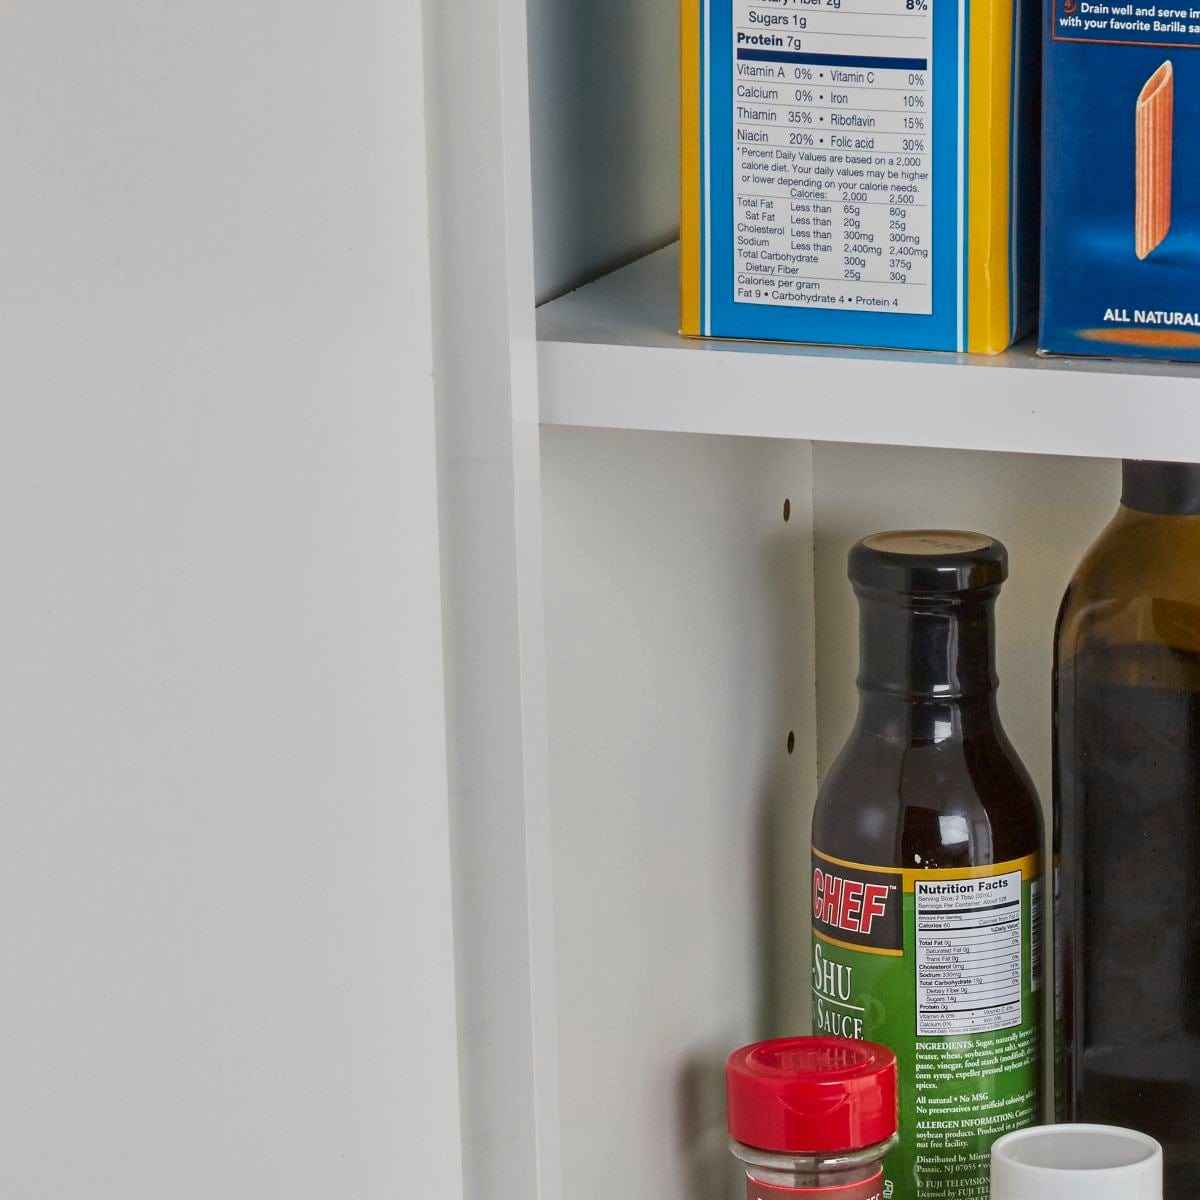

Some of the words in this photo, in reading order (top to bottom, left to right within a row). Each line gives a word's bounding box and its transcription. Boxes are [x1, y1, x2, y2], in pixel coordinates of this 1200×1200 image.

[906, 0, 927, 11] 8%
[1081, 3, 1109, 14] Drain
[1111, 5, 1132, 16] well
[1135, 7, 1154, 17] and
[1157, 10, 1187, 18] serve
[748, 13, 789, 26] Sugars
[792, 15, 806, 28] 1g
[1060, 18, 1081, 27] with
[1084, 22, 1107, 30] your
[1110, 19, 1150, 31] favorite
[1153, 21, 1186, 33] Barilla
[737, 33, 783, 47] Protein
[787, 37, 801, 50] 7g
[737, 65, 774, 77] Vitamin
[776, 67, 785, 78] A
[794, 68, 812, 80] 0%
[831, 71, 864, 83] Vitamin
[866, 72, 874, 83] C
[908, 74, 924, 85] 0%
[737, 87, 778, 100] Calcium
[795, 90, 812, 101] 0%
[831, 93, 848, 103] Iron
[903, 96, 924, 107] 10%
[737, 107, 776, 121] Thiamin
[789, 112, 812, 124] 35%
[831, 115, 875, 127] Riboflavin
[903, 118, 923, 129] 15%
[737, 130, 768, 142] Niacin
[790, 133, 813, 146] 20%
[831, 136, 852, 148] Folic
[855, 138, 874, 149] acid
[903, 140, 923, 151] 30%
[776, 150, 796, 161] Daily
[799, 152, 827, 162] Values
[845, 155, 871, 165] based
[896, 158, 921, 168] 2,000
[742, 161, 769, 173] calorie
[771, 163, 789, 173] diet.
[792, 164, 812, 174] Your
[815, 166, 834, 177] daily
[837, 168, 864, 177] values
[866, 171, 885, 181] may
[888, 170, 899, 179] be
[901, 171, 928, 183] higher
[752, 175, 775, 185] lower
[777, 177, 821, 190] depending
[838, 182, 857, 191] your
[859, 181, 888, 192] calorie
[890, 182, 919, 193] needs.
[737, 198, 757, 208] Total
[760, 199, 773, 209] Fat
[790, 202, 810, 212] Less
[813, 204, 831, 214] than
[844, 205, 860, 216] 65g
[889, 207, 905, 218] 80g
[738, 249, 758, 259] Total
[761, 250, 818, 264] Carbohydrate
[844, 257, 865, 268] 300g
[889, 259, 911, 270] 375g
[738, 275, 774, 286] Calories
[777, 279, 793, 288] per
[796, 280, 819, 290] gram
[738, 288, 753, 298] Fat
[755, 289, 761, 298] 9
[772, 291, 835, 304] Carbohydrate
[838, 295, 844, 304] 4
[856, 296, 889, 305] Protein
[892, 298, 898, 306] 4
[1104, 309, 1130, 322] ALL
[919, 884, 973, 894] Nutrition
[979, 879, 1008, 891] Facts
[813, 868, 889, 935] CHEF
[817, 999, 865, 1041] SAUCE
[916, 1041, 974, 1050] INGREDIENTS:
[972, 1093, 988, 1101] MSG
[961, 1114, 1014, 1127] INFORMATION:
[917, 1155, 956, 1163] Distributed
